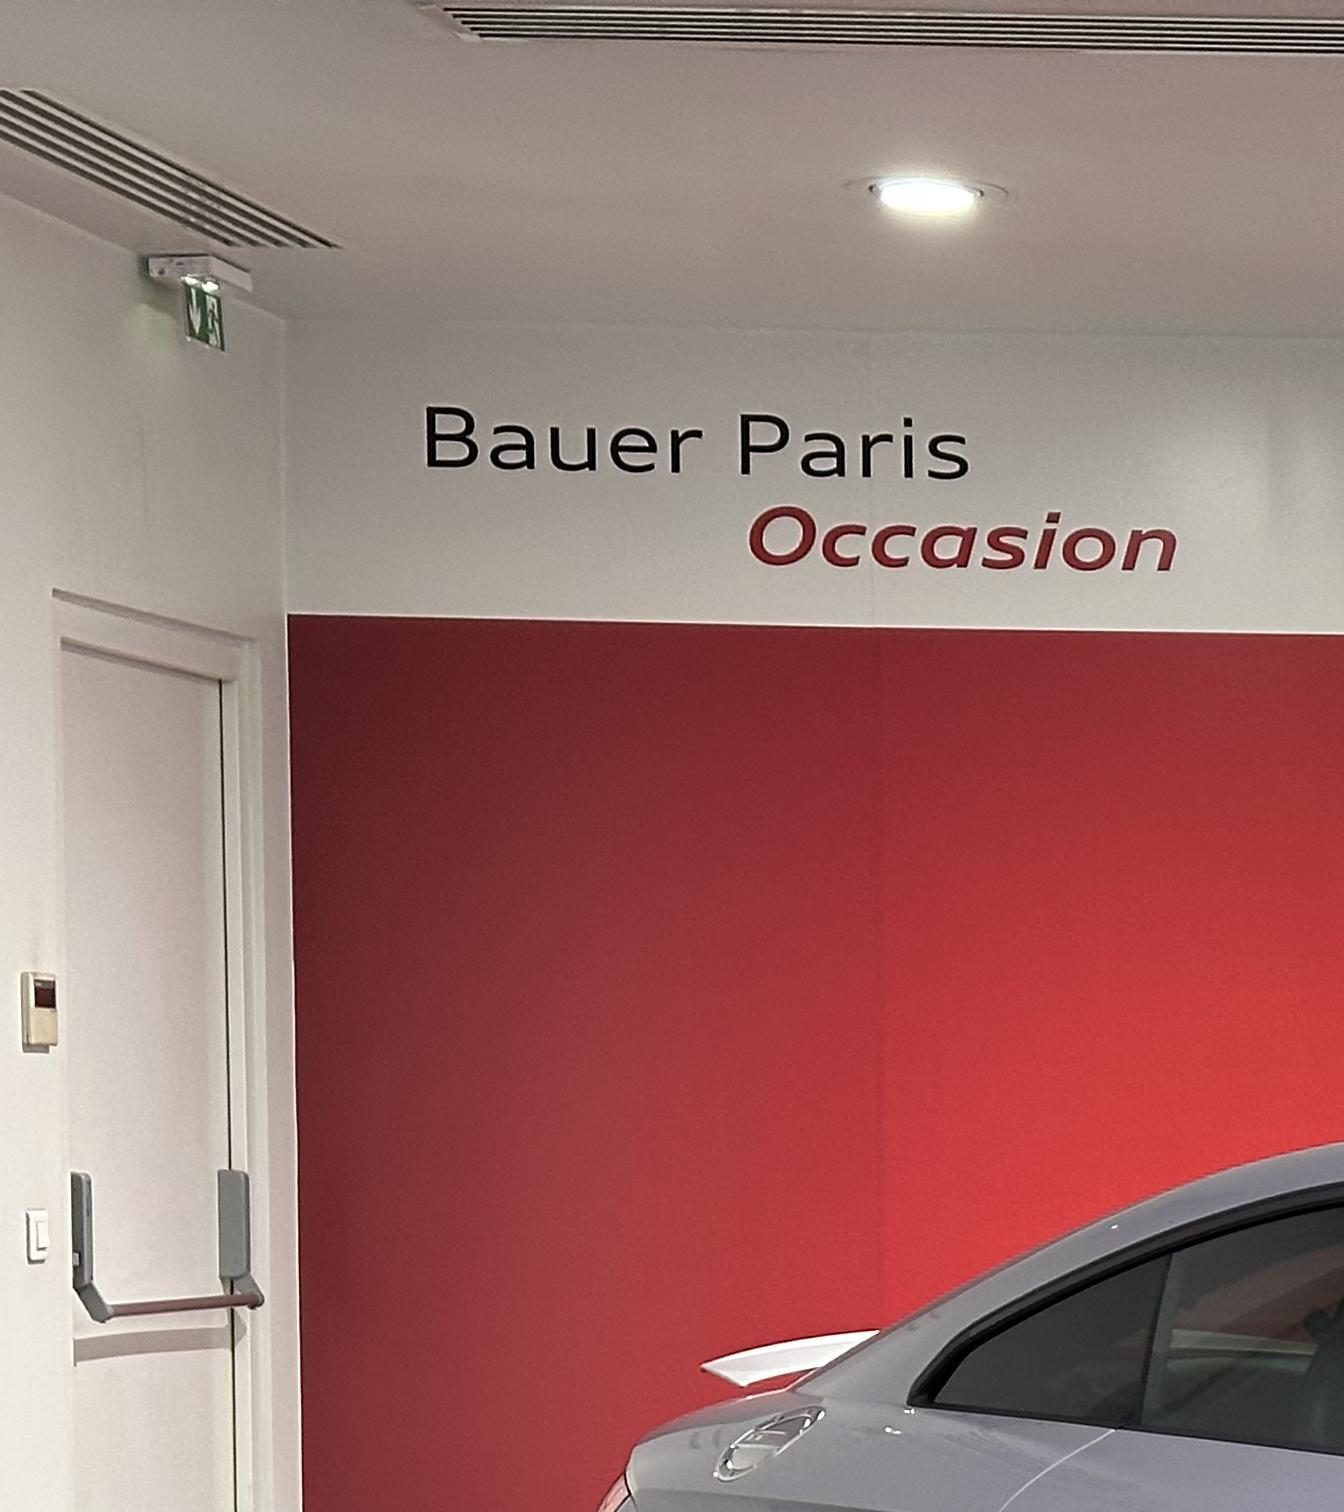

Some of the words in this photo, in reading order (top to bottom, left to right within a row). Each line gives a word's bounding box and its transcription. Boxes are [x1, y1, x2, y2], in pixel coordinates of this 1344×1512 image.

[423, 404, 704, 475] Bauer
[738, 412, 971, 481] Paris
[748, 504, 1178, 572] Occasion
